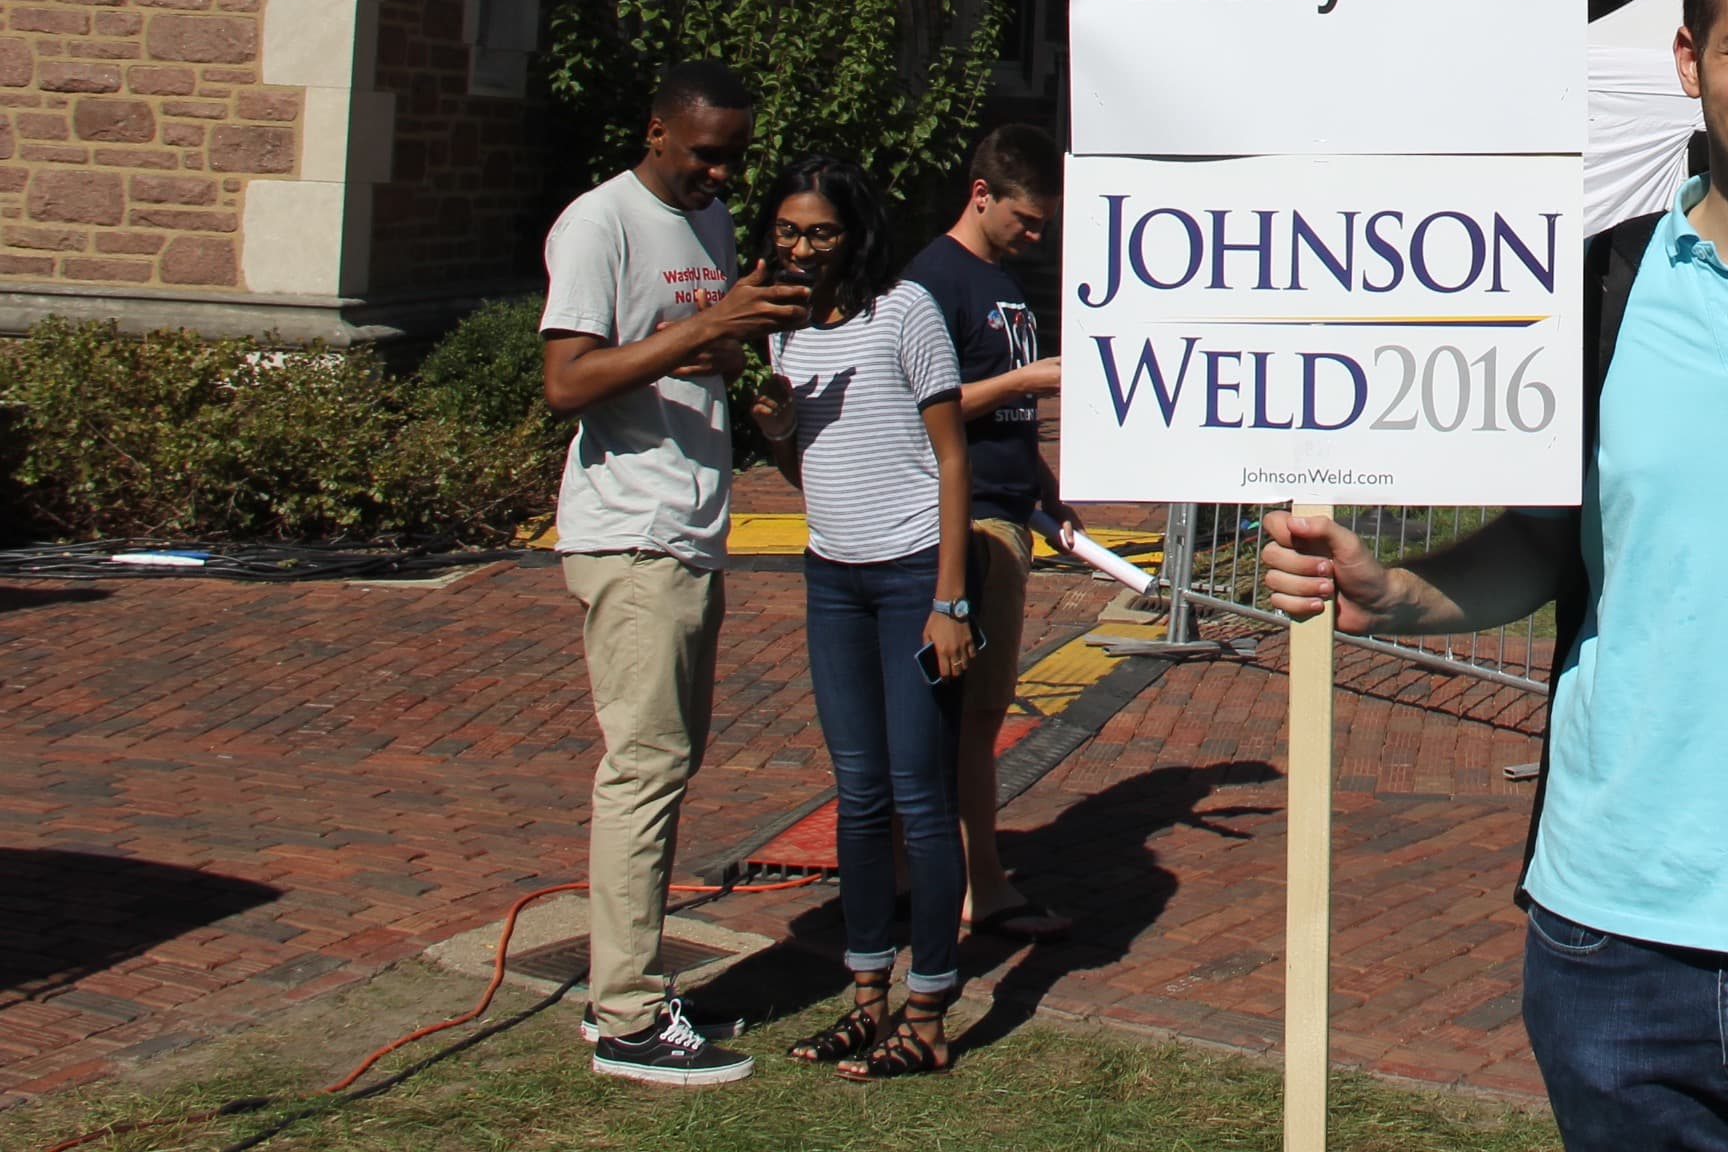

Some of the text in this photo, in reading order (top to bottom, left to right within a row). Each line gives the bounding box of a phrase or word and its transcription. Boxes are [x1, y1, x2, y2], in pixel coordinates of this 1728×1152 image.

[1077, 194, 1562, 309] JOHNSON
[662, 267, 700, 284] WashU
[675, 289, 692, 304] No
[1241, 467, 1394, 487] JohnsonWeld.com
